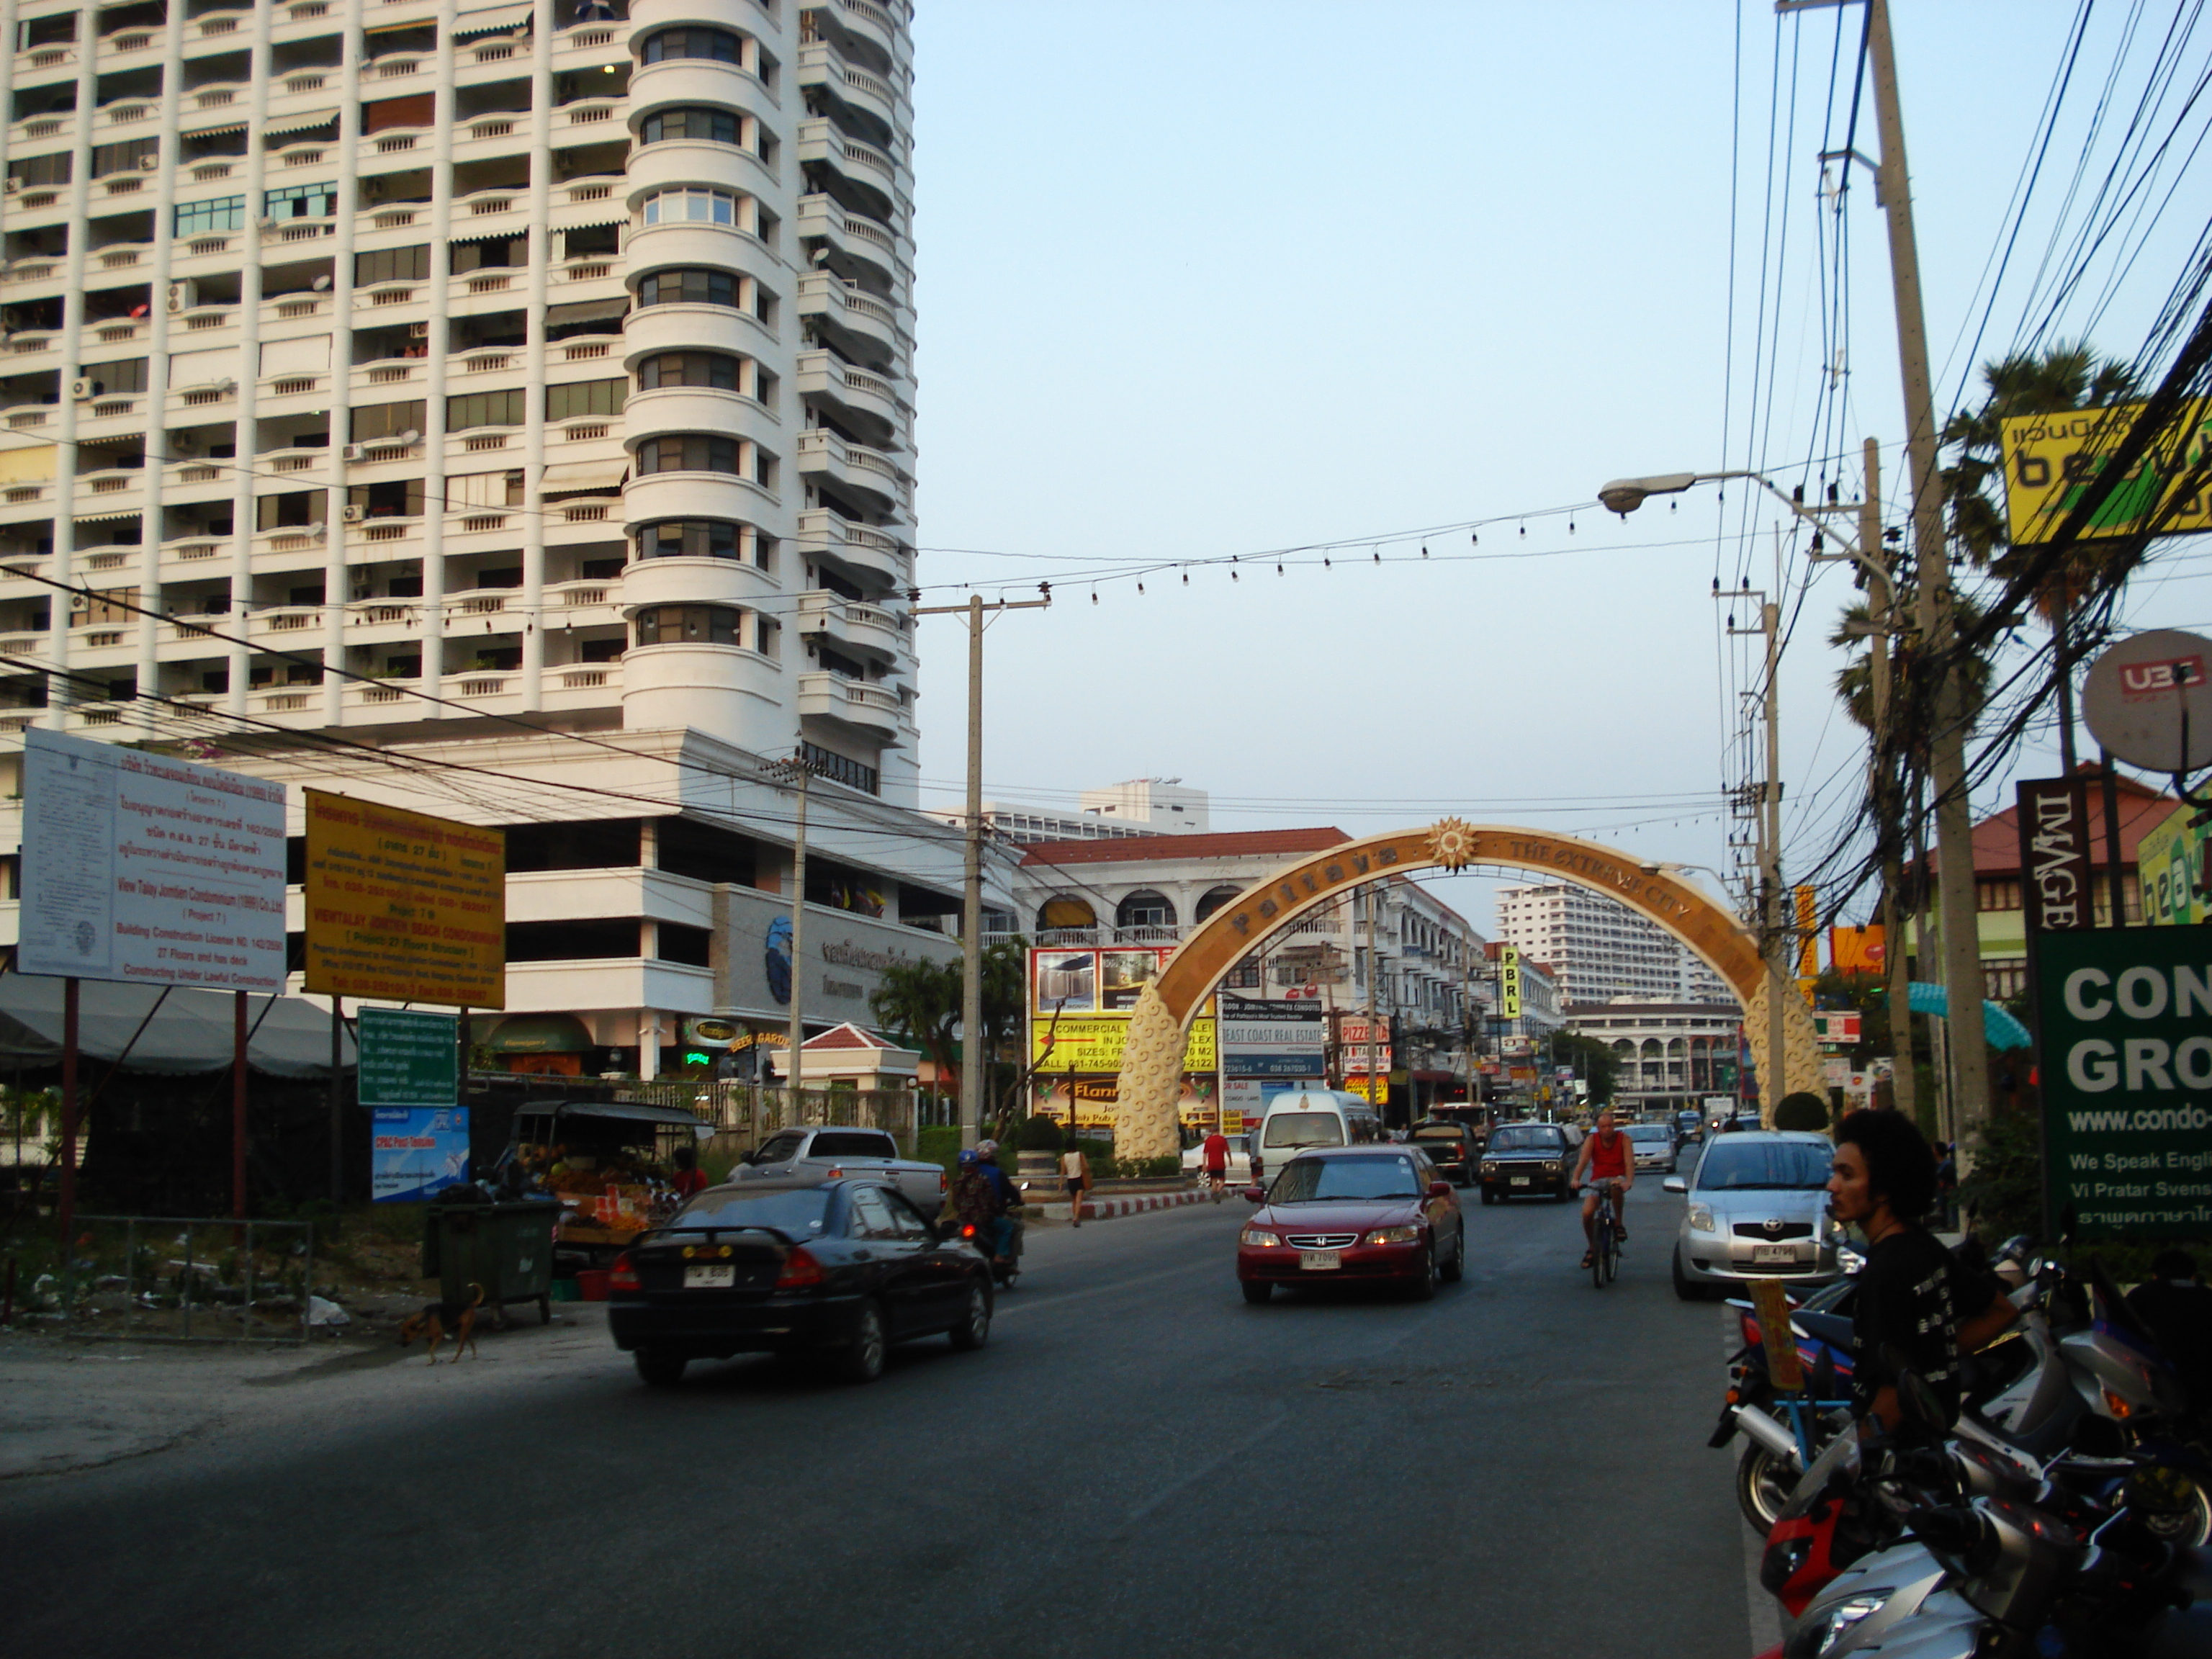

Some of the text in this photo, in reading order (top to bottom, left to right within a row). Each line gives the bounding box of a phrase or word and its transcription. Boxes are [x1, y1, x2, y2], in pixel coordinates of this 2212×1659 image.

[413, 845, 425, 856] 27
[2031, 791, 2082, 930] IMAGE
[1232, 848, 1398, 935] Pattaya
[1509, 840, 1552, 862] THE
[1645, 886, 1691, 918] CITY
[117, 922, 150, 939] Building
[153, 926, 202, 942] Construction
[1505, 952, 1517, 1014] PBRL
[2064, 965, 2212, 1021] CON
[1055, 1024, 1212, 1034] COMMERCIAL ALE!
[1247, 1028, 1272, 1042] COAST
[1274, 1029, 1293, 1043] REAL
[1296, 1029, 1321, 1042] ESTATE
[1342, 1026, 1388, 1040] PIZZEIA
[729, 1033, 791, 1053] BEER GARDE
[1103, 1036, 1112, 1045] IN
[1117, 1036, 1130, 1045] JO
[1076, 1048, 1108, 1056] SIZES:
[1111, 1048, 1126, 1056] FR
[2067, 1035, 2212, 1093] GRO
[1233, 1082, 1249, 1090] SALE
[1093, 1113, 1111, 1122] Pub
[2067, 1102, 2212, 1133] www.condo-
[2069, 1151, 2212, 1173] We Speak Engli
[2070, 1181, 2212, 1198] Vi Pratar Svens
